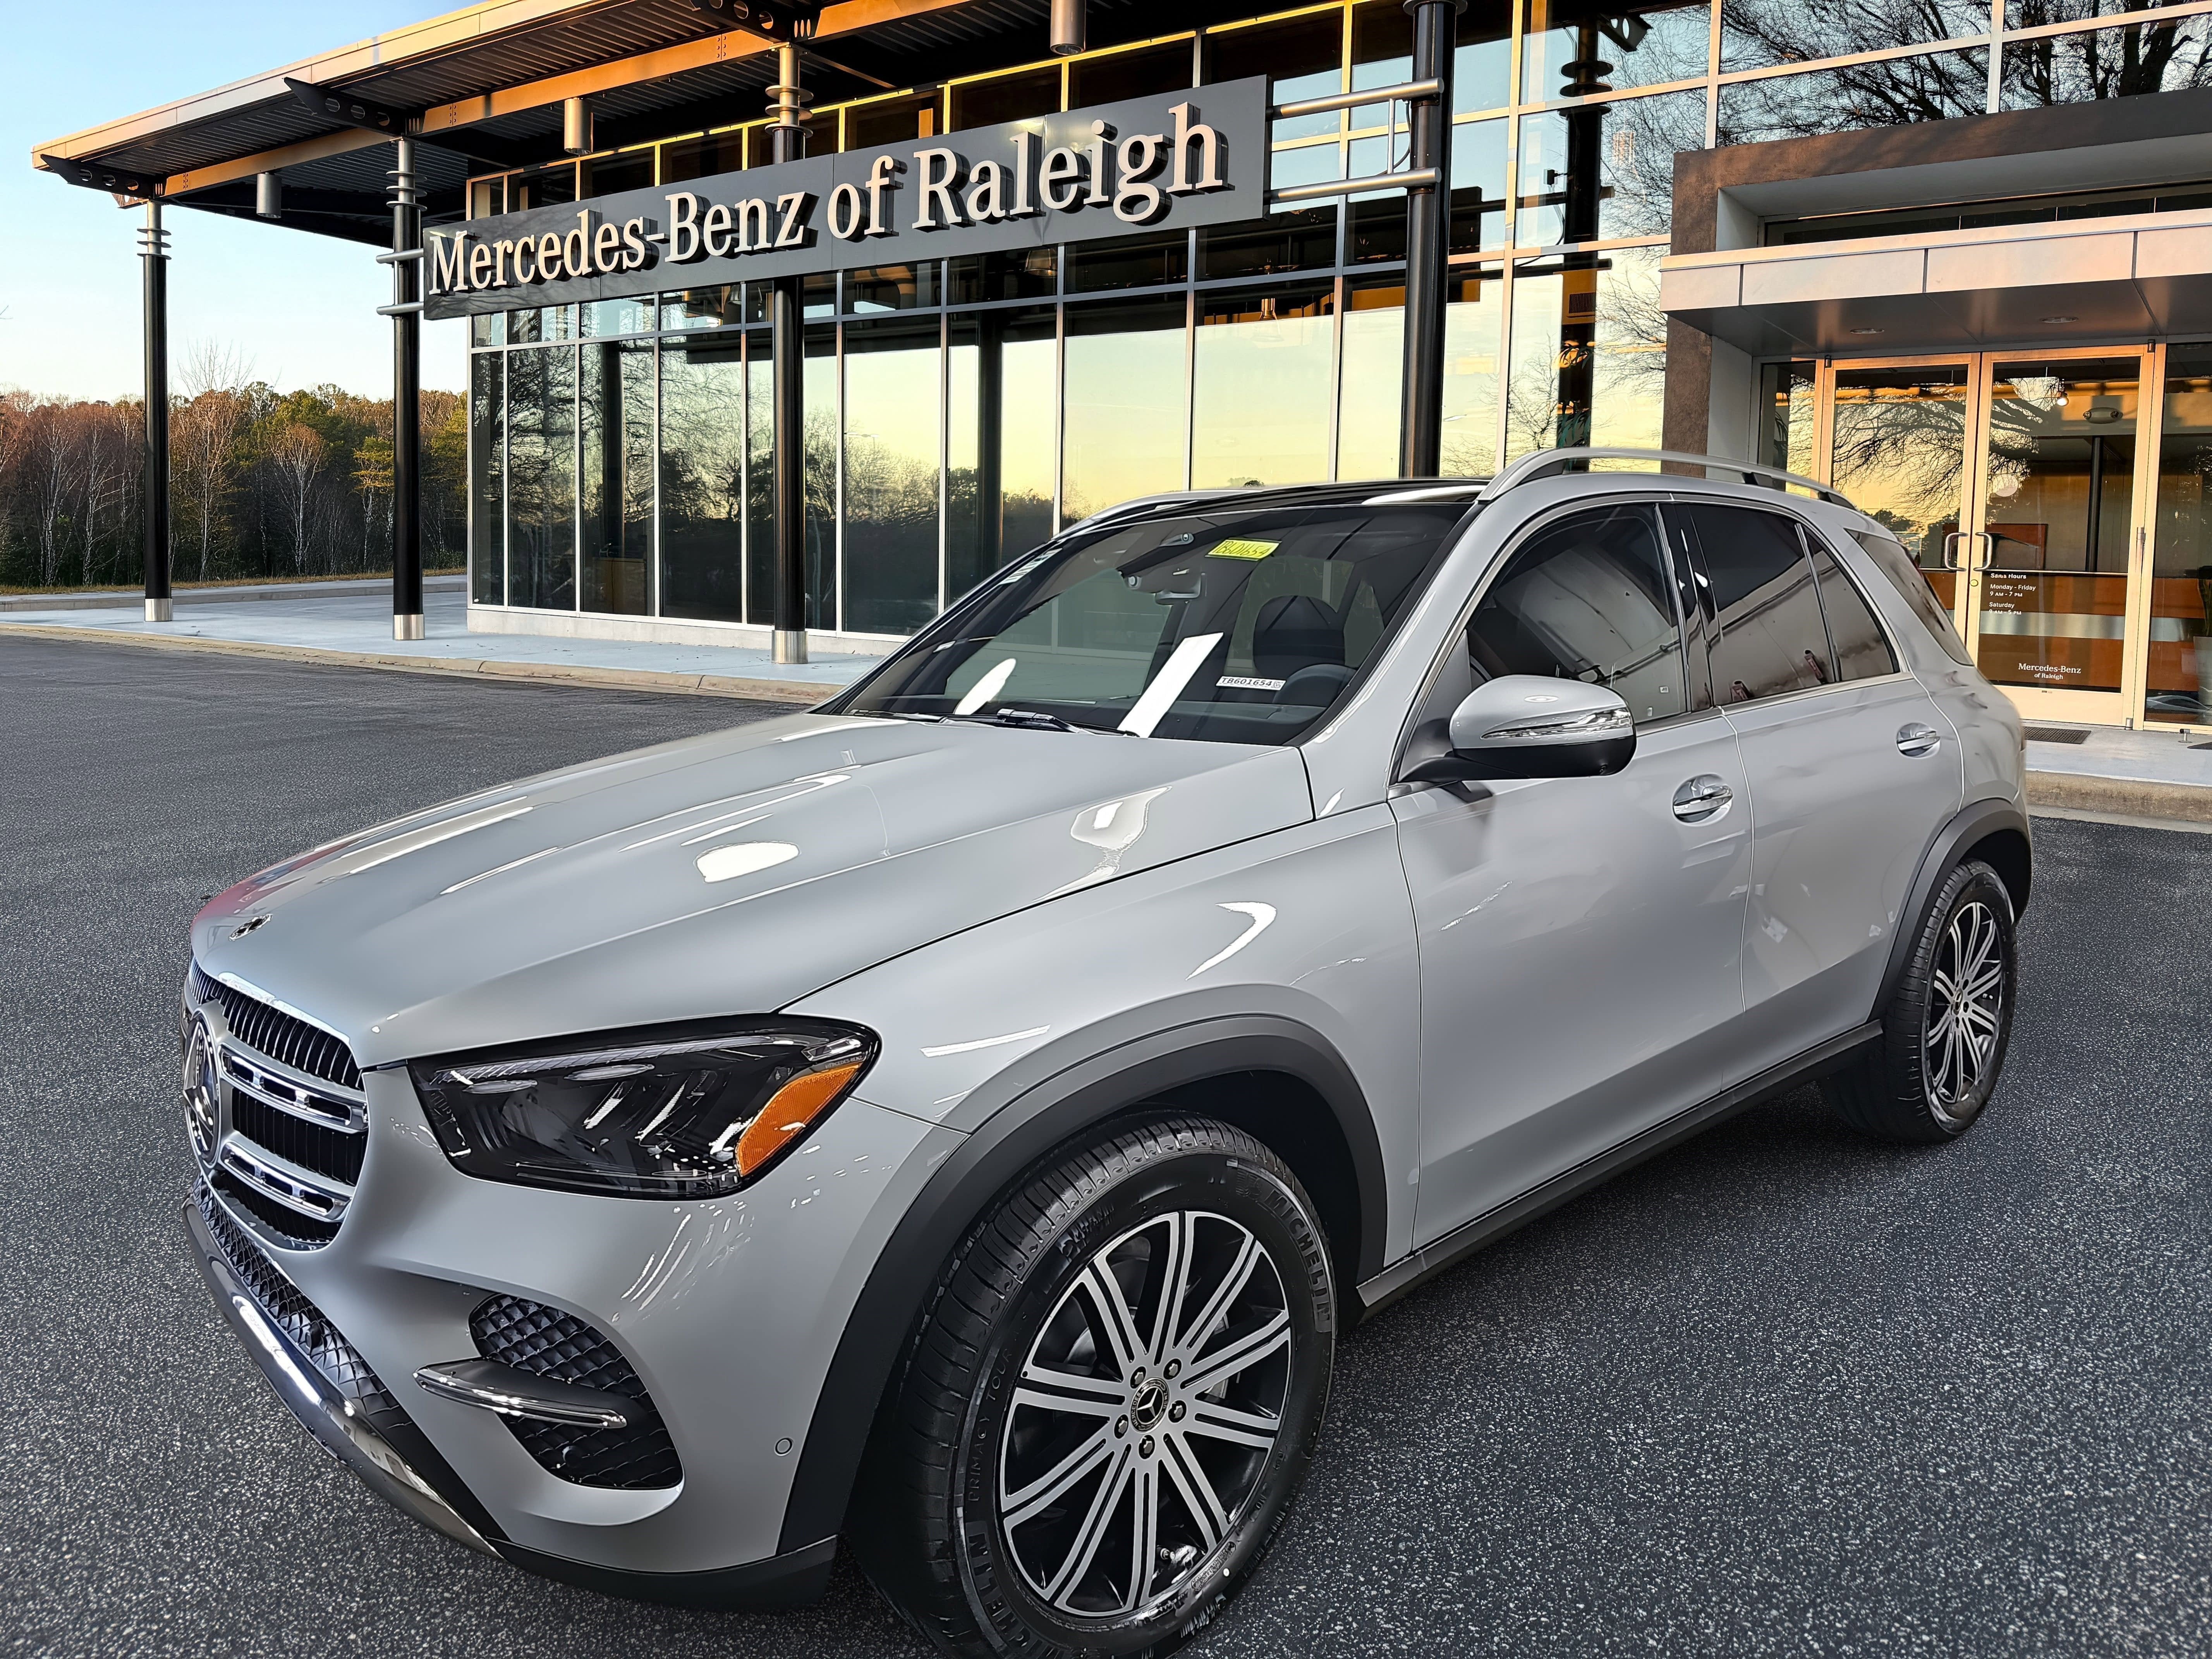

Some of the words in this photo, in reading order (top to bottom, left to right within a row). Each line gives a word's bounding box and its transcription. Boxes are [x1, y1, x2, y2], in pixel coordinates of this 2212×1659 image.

[428, 191, 809, 295] Mercedes-Benz
[827, 155, 895, 240] of
[912, 101, 1225, 230] Raleigh
[1221, 678, 1272, 686] TB601654
[2018, 663, 2081, 674] Mercedes-Benz
[1264, 1189, 1331, 1321] MICHELIN
[968, 1416, 990, 1501] PRIMACY
[986, 1348, 1012, 1401] TOUR
